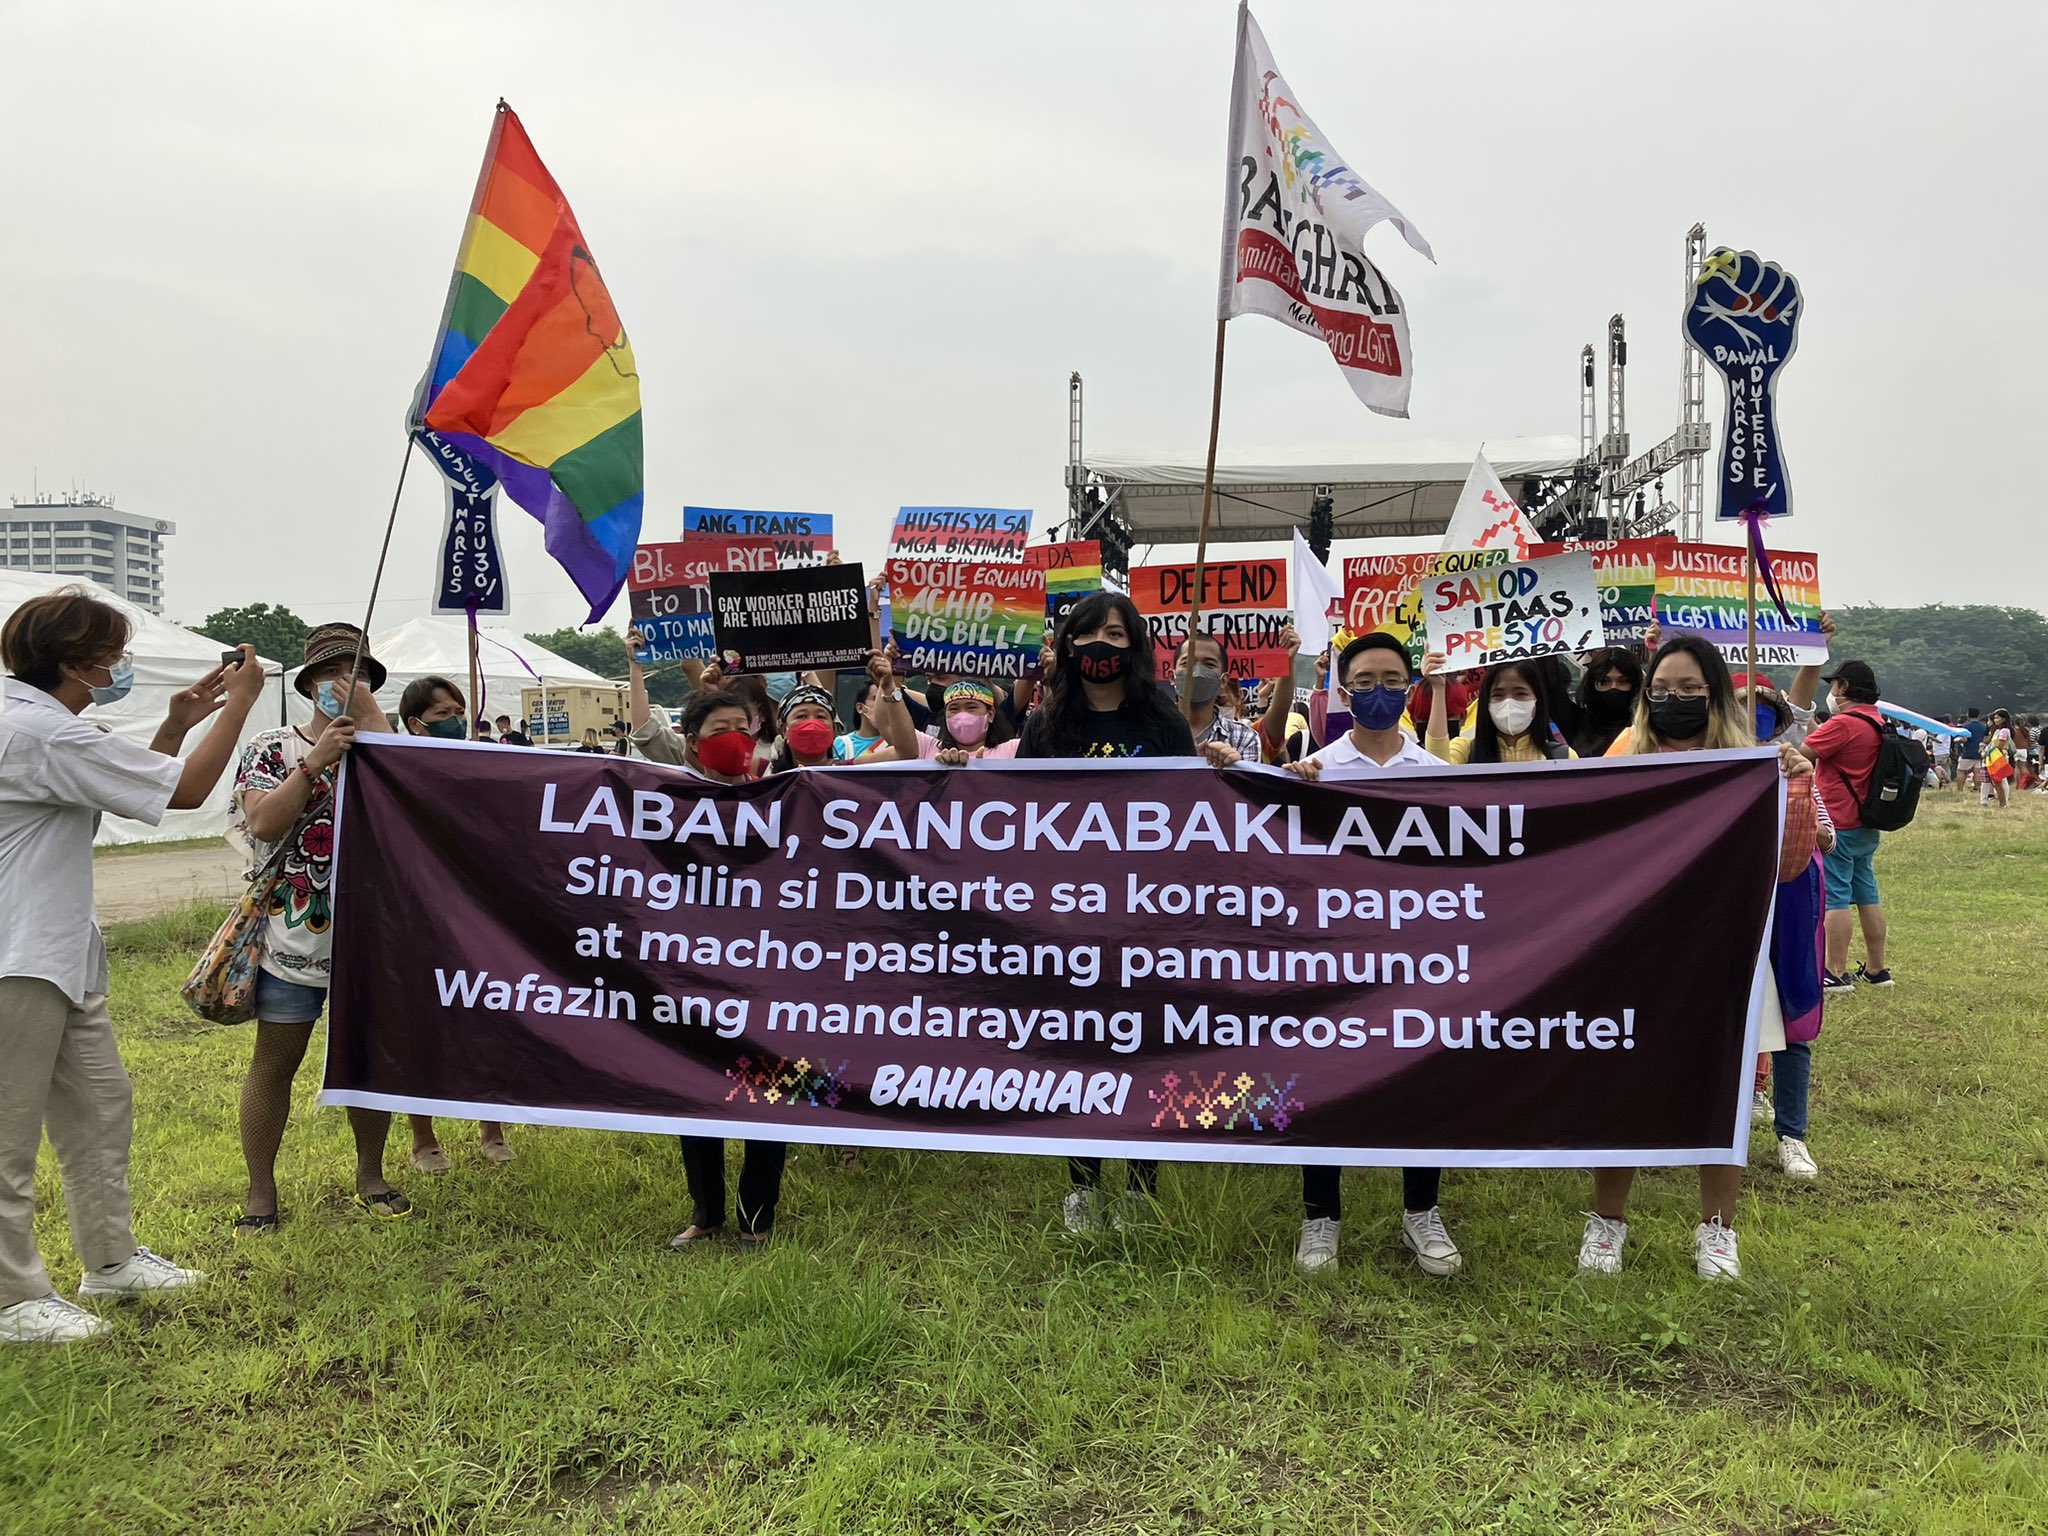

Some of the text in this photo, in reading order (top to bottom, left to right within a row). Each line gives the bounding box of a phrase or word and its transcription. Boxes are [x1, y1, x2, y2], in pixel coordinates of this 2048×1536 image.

[1713, 344, 1780, 367] BAWAL
[1729, 378, 1749, 484] MARCOS
[696, 514, 812, 536] ANG TRANS
[903, 511, 1029, 537] HUSTISYA SA
[448, 508, 469, 594] MARCOS
[895, 536, 939, 555] MGA
[944, 537, 1025, 561] BIKTIMA!
[1047, 546, 1075, 570] DA
[1562, 540, 1619, 553] SAHOD
[892, 561, 1047, 592] SOGIE EQUALITY
[1348, 556, 1407, 580] HANDS
[1445, 550, 1505, 573] QUEER
[1664, 550, 1738, 575] JUSTICE
[1769, 559, 1816, 584] CHAD
[717, 588, 859, 614] GAY WORKER RIGHTS
[1160, 564, 1277, 605] DEFEND
[1435, 567, 1538, 612] SAHOD
[1664, 576, 1745, 601] JUSTICE
[1782, 585, 1814, 609] ALL
[646, 589, 680, 618] to
[722, 604, 858, 629] ARE HUMAN RIGHTS
[1474, 590, 1589, 629] ITAAS,
[1665, 603, 1809, 633] LGBT MARTYRS!
[660, 620, 684, 640] TO
[905, 614, 948, 642] DIS
[951, 621, 1028, 651] BILL!
[1207, 612, 1289, 651] FREEDOM
[1445, 616, 1564, 656] PRESYO
[1080, 654, 1121, 678] RISE
[539, 783, 1525, 859] LABAN, SANGKABAKLAAN!
[565, 854, 1487, 929] Singilin si Duterte sa korap, papet
[575, 922, 1470, 988] at macho-pasistang pamumuno!
[435, 968, 1636, 1053] Wafazin ang mandarayang Marcos-Duterte!
[869, 1063, 1134, 1116] BAHAGHARI
